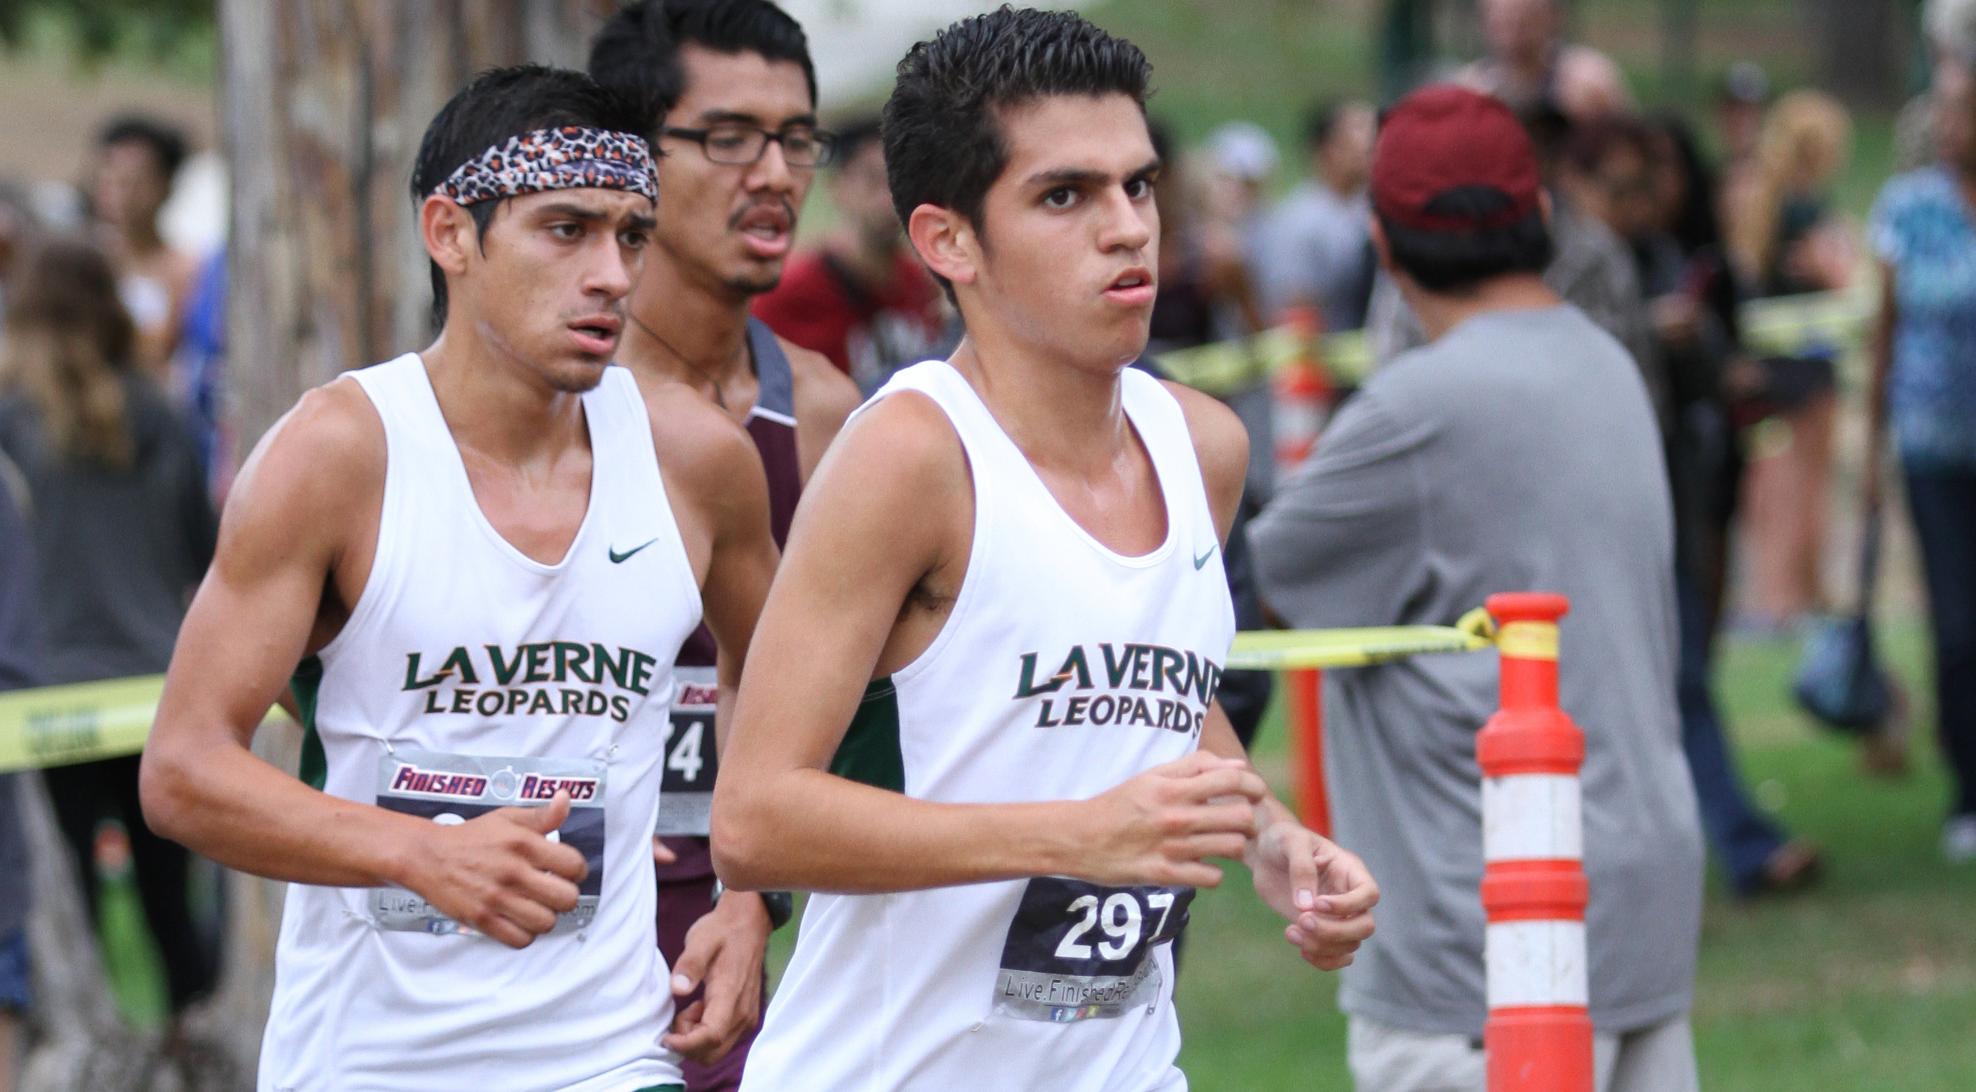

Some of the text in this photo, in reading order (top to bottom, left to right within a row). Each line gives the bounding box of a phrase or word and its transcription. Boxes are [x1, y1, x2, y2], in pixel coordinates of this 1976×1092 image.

[402, 641, 657, 697] LA VERNE
[1012, 644, 1095, 700] LA
[424, 688, 630, 722] LEOPARDS
[1034, 694, 1204, 740] LEOPARDS
[393, 766, 488, 797] FINISHED
[1054, 892, 1175, 961] 297
